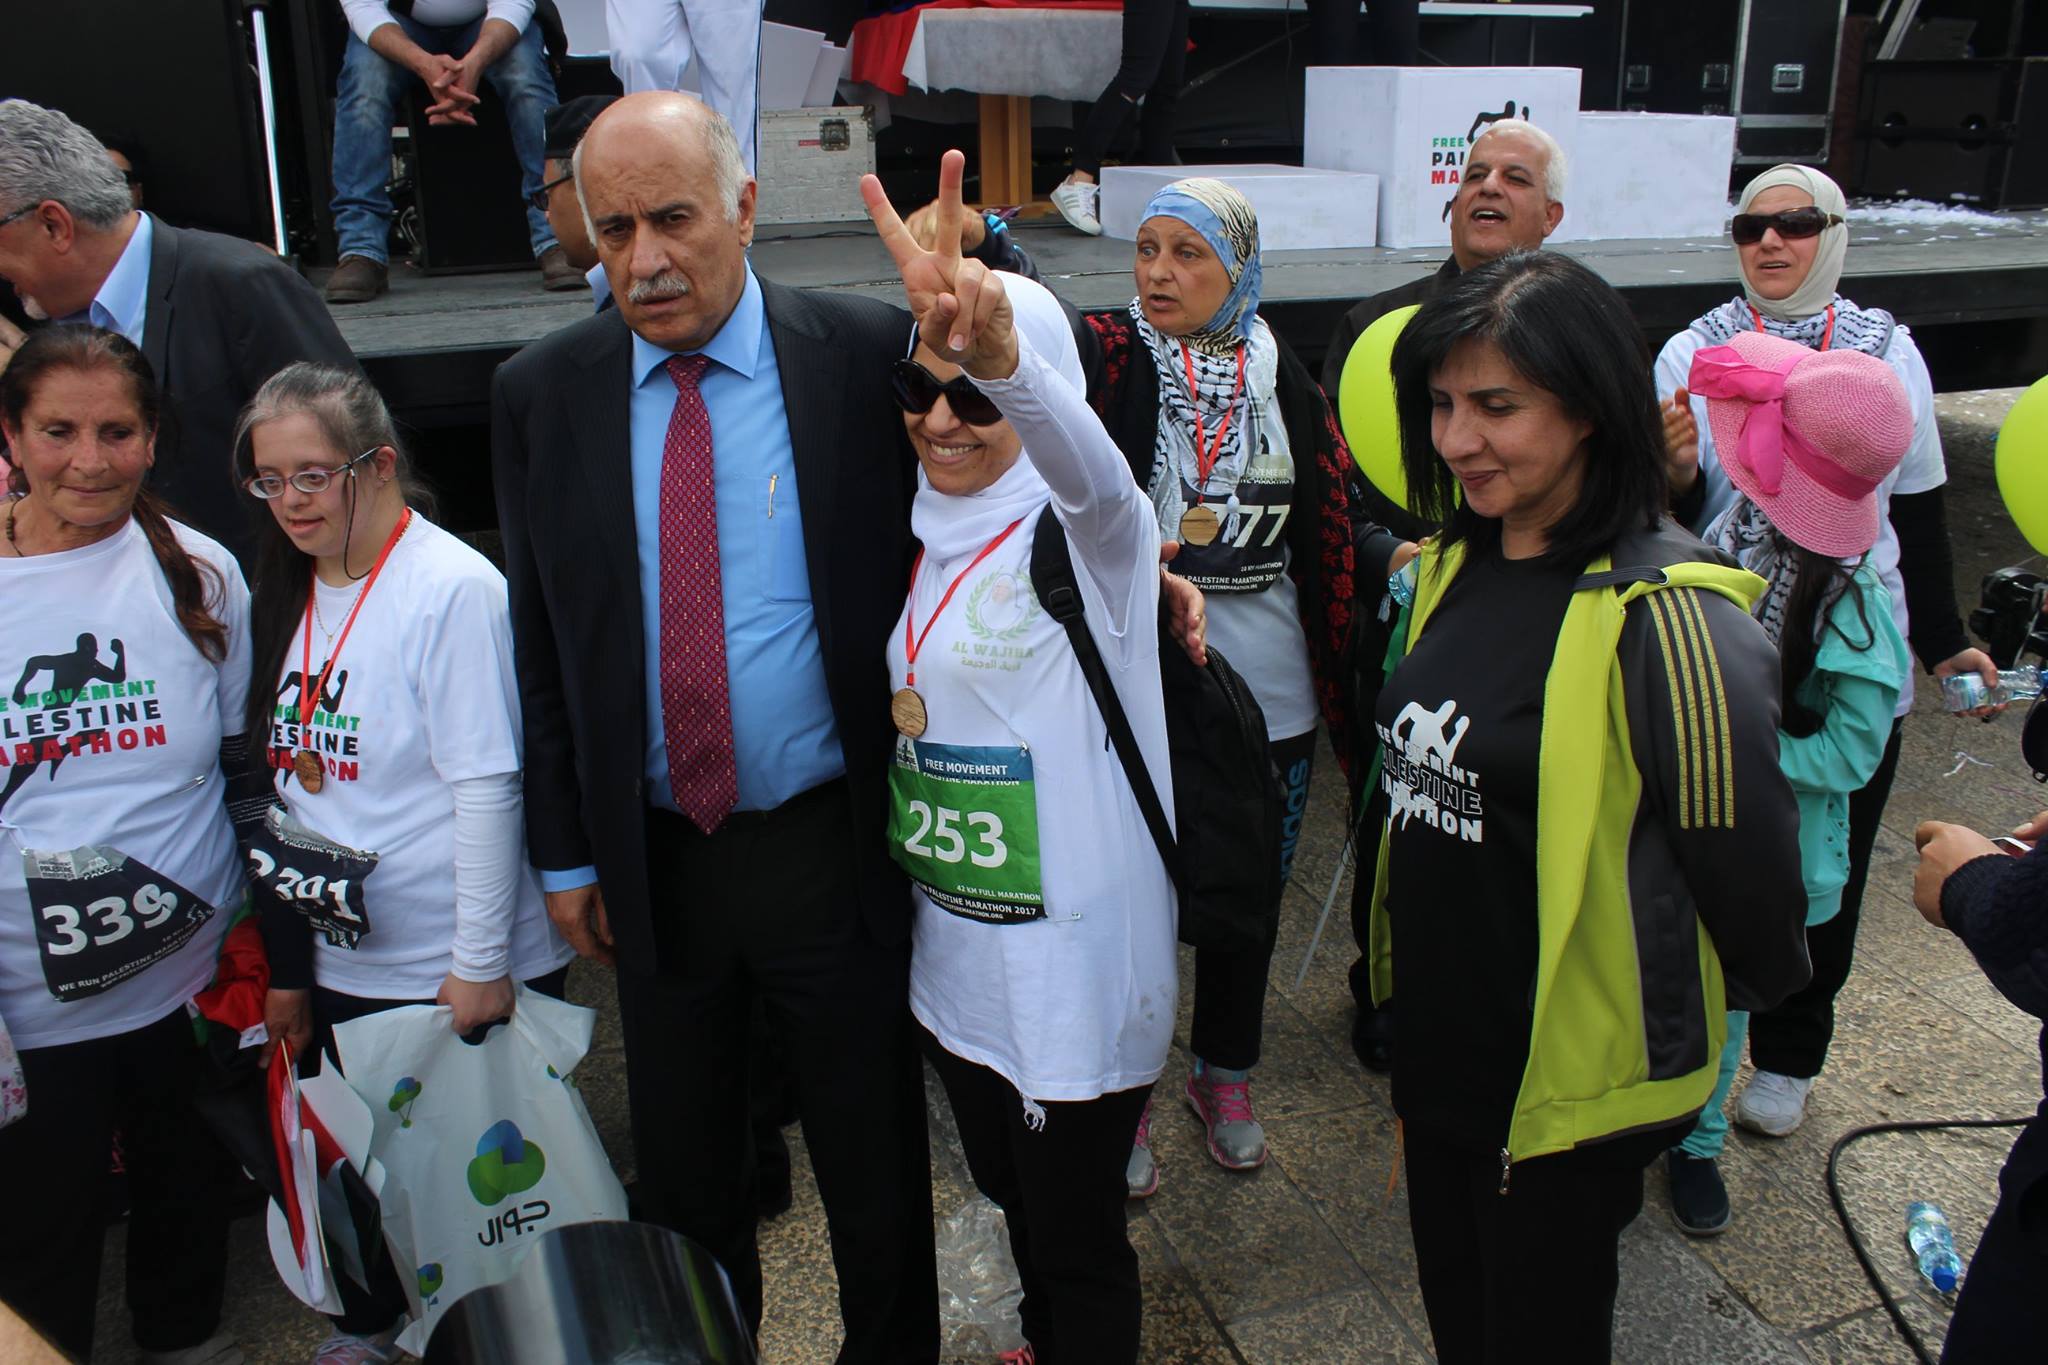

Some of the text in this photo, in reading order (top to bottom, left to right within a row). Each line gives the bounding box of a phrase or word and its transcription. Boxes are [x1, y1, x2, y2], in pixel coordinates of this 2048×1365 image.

[1432, 137, 1465, 147] FREE
[1431, 170, 1459, 184] MA
[1187, 575, 1230, 584] PALESTINE
[20, 679, 156, 709] MOVEMENT
[274, 724, 358, 756] ESINE
[925, 758, 944, 771] FREE
[946, 762, 1008, 775] MOVEMENT
[963, 775, 1020, 786] MARATHON
[904, 799, 1008, 868] 253
[928, 886, 964, 905] PALESTINE
[965, 899, 1012, 913] MARATHON
[1015, 906, 1036, 915] 2017
[957, 884, 1042, 901] 42 KM FULL MARATHON
[42, 883, 178, 956] 339
[58, 981, 76, 992] WE
[78, 977, 100, 988] RUN
[102, 953, 153, 981] PALESTINE
[478, 1199, 551, 1247] جوال
